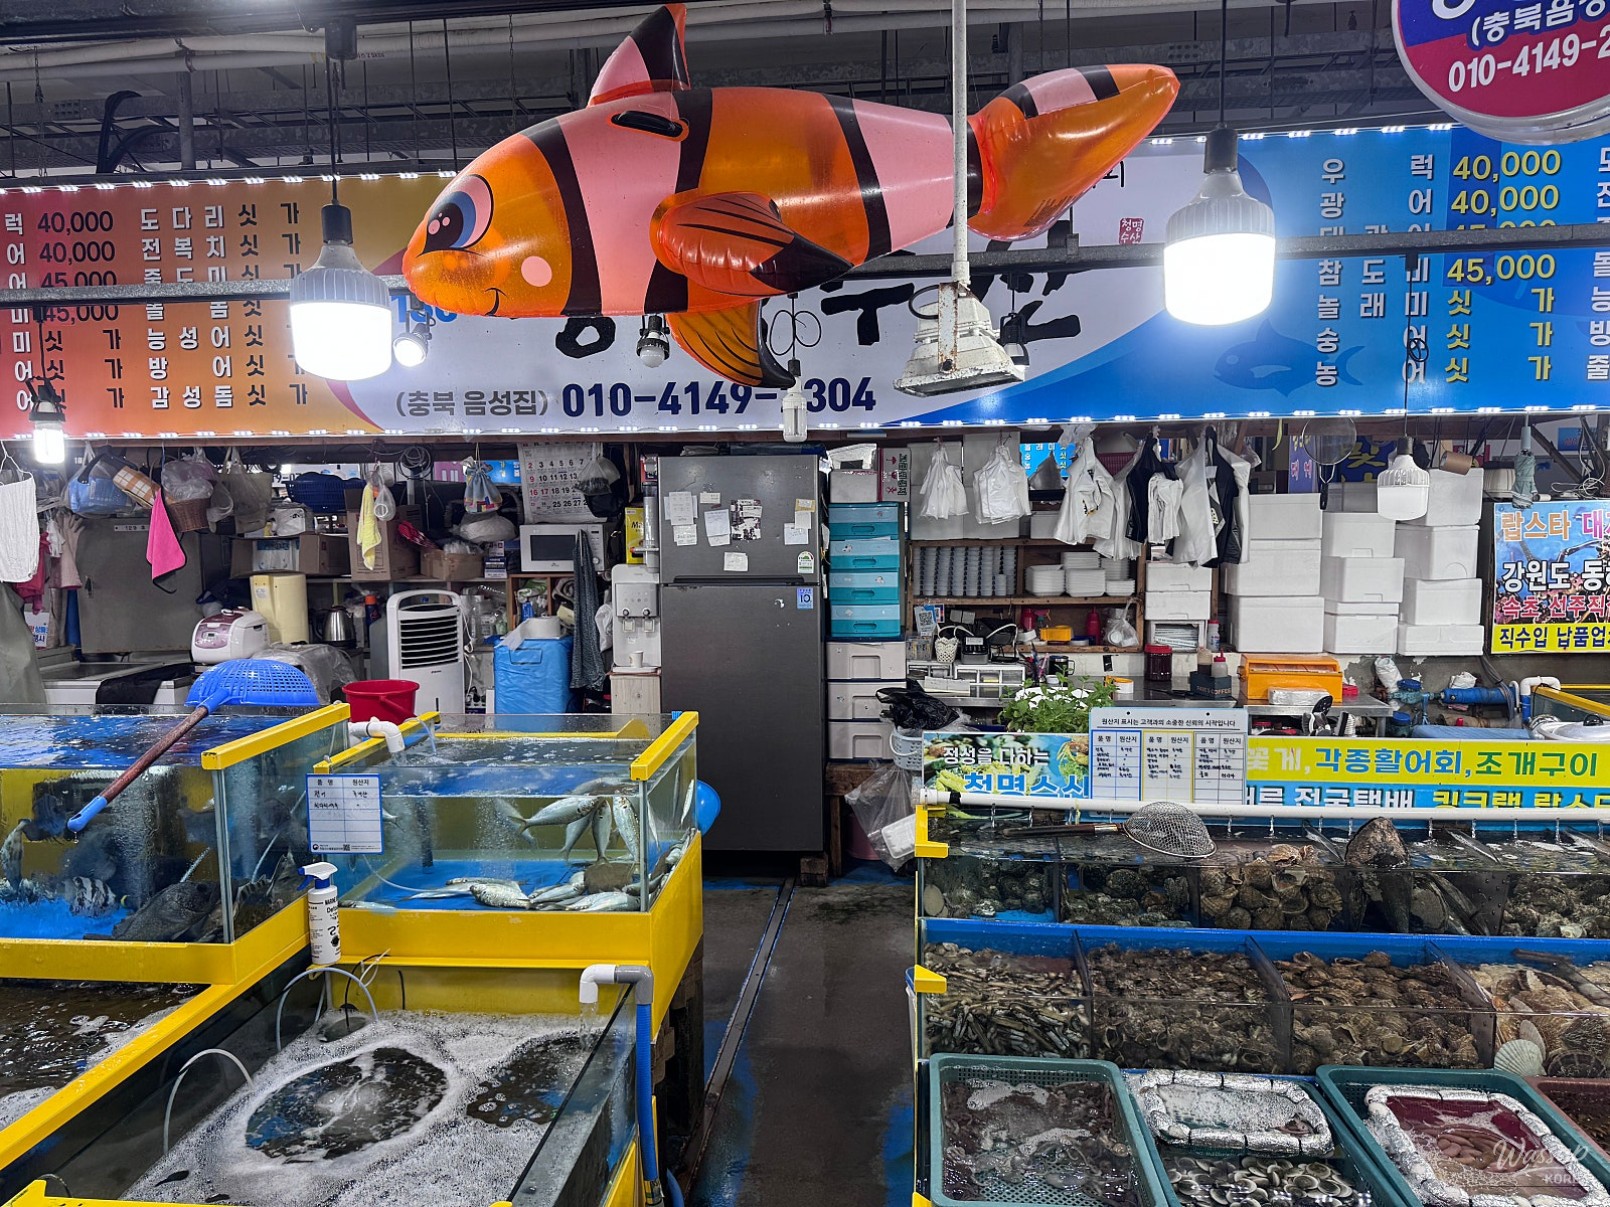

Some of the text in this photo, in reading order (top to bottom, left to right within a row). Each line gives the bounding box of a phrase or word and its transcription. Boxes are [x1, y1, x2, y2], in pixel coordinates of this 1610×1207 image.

[1453, 150, 1562, 182] 40,000
[1451, 185, 1559, 217] 40,000
[37, 211, 114, 235] 40,000
[39, 240, 116, 265] 40,000
[41, 270, 118, 288] 45000
[1447, 254, 1555, 285] 45,000
[396, 376, 876, 417] (충북 음성집) 010-4149-304
[1501, 511, 1570, 541] 랍스타
[1502, 559, 1610, 592] 강원도 동
[1502, 594, 1610, 618] 속초 선주직
[1500, 626, 1610, 649] 직수입 납품업
[1121, 718, 1139, 726] 표시는
[1140, 718, 1165, 726] 고객과의
[1205, 719, 1236, 727] 시작입니다
[943, 747, 1050, 766] 정성을 다하는
